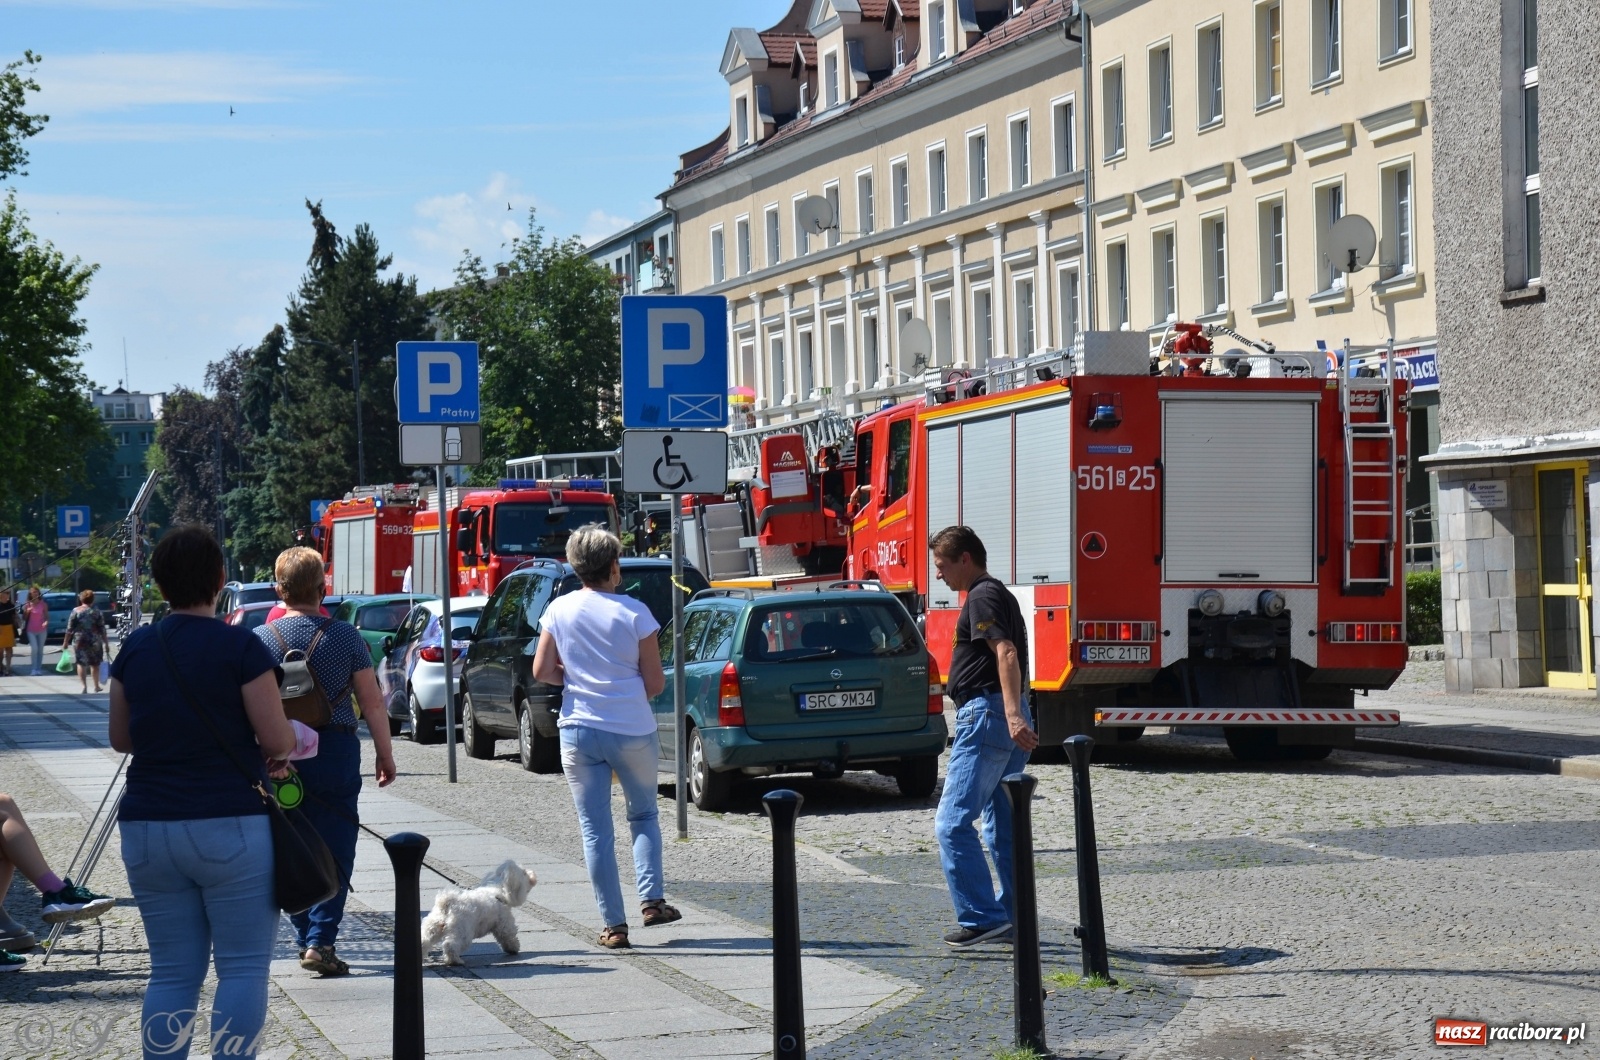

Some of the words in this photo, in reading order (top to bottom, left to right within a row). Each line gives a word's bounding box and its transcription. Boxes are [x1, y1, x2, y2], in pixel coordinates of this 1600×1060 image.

[648, 308, 705, 388] P
[1381, 360, 1436, 380] TERACE
[417, 351, 462, 413] P
[441, 407, 476, 419] Płatny
[65, 510, 83, 533] P
[1089, 647, 1115, 660] SRC
[1118, 647, 1148, 660] 21TR
[808, 694, 838, 709] SRC
[841, 691, 874, 707] 9M34
